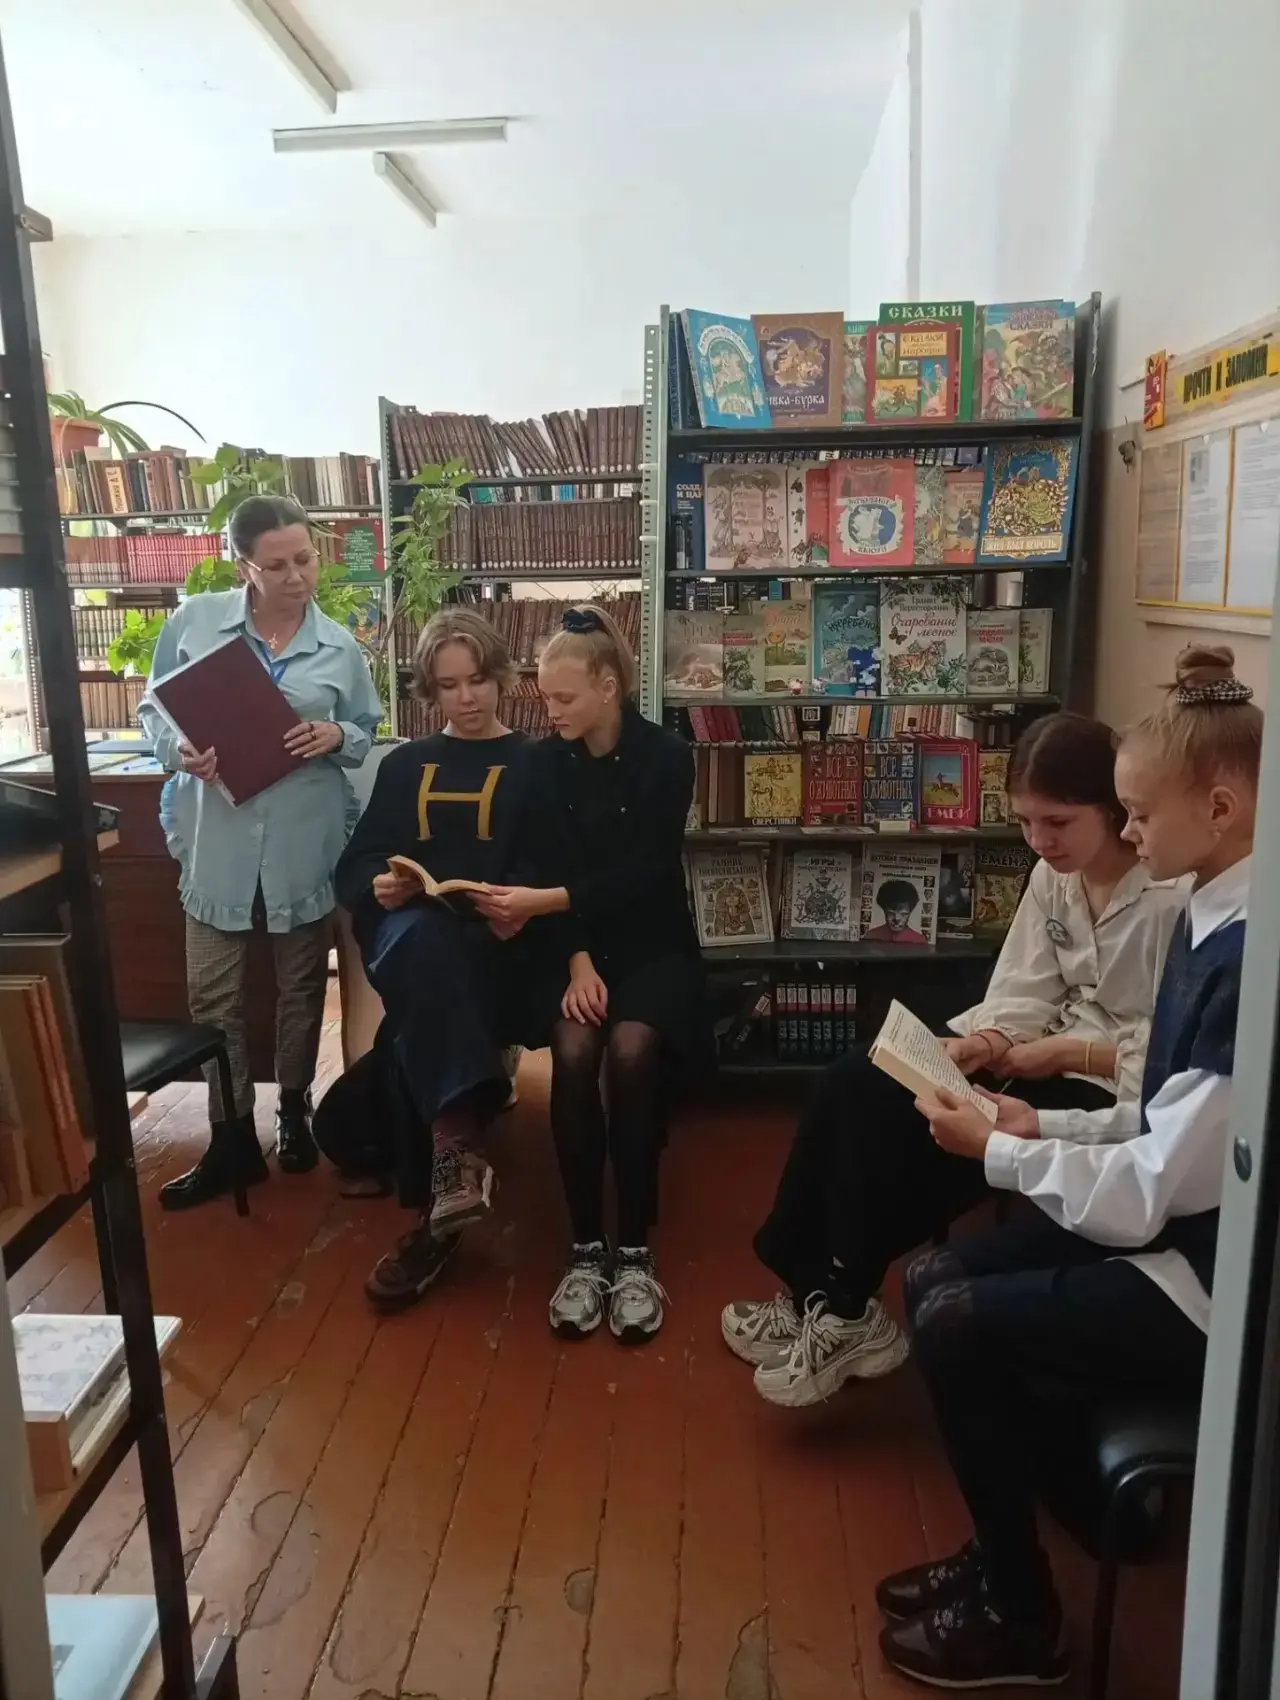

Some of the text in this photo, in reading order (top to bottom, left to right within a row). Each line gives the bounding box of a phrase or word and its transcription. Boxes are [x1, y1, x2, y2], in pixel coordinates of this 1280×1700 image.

[888, 304, 963, 319] СКАЗКИ
[1216, 360, 1223, 392] И
[826, 756, 842, 778] ВСЕ
[880, 756, 897, 778] ВСЕ
[809, 780, 857, 800] О ЖИВОТНЫХ
[862, 780, 913, 800] О ЖИВОТНЫХ
[416, 763, 508, 842] H
